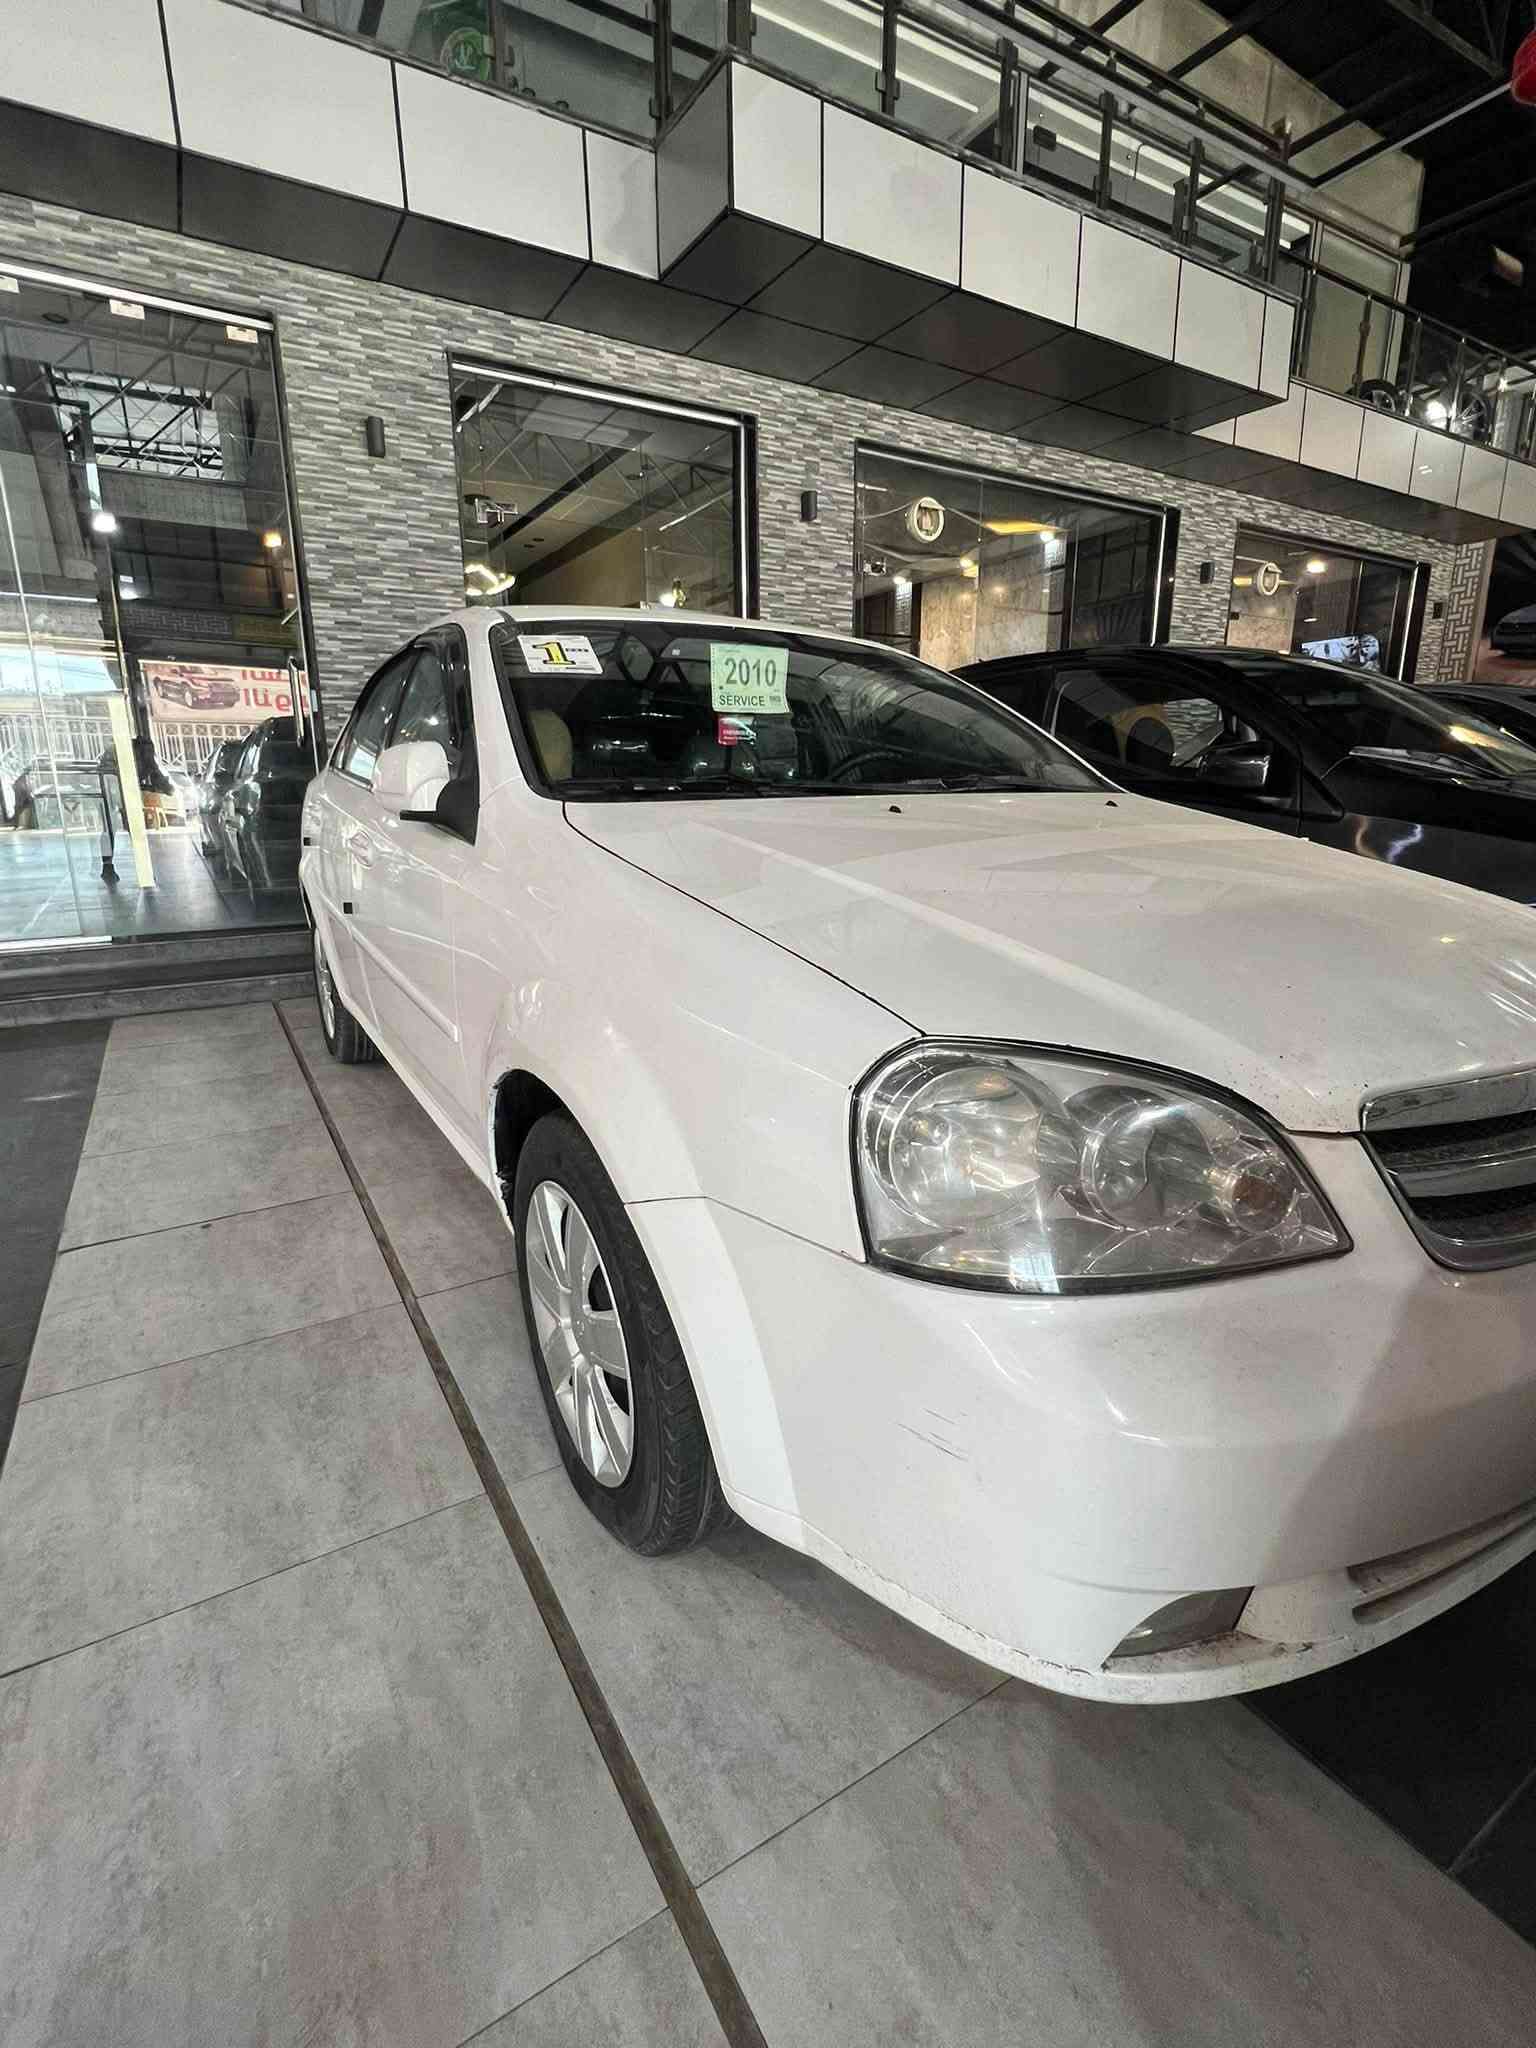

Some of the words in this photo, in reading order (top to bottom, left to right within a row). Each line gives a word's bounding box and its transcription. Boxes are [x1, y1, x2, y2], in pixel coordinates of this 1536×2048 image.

[532, 641, 576, 665] 1
[725, 657, 777, 687] 2010
[719, 694, 766, 707] SERVICE
